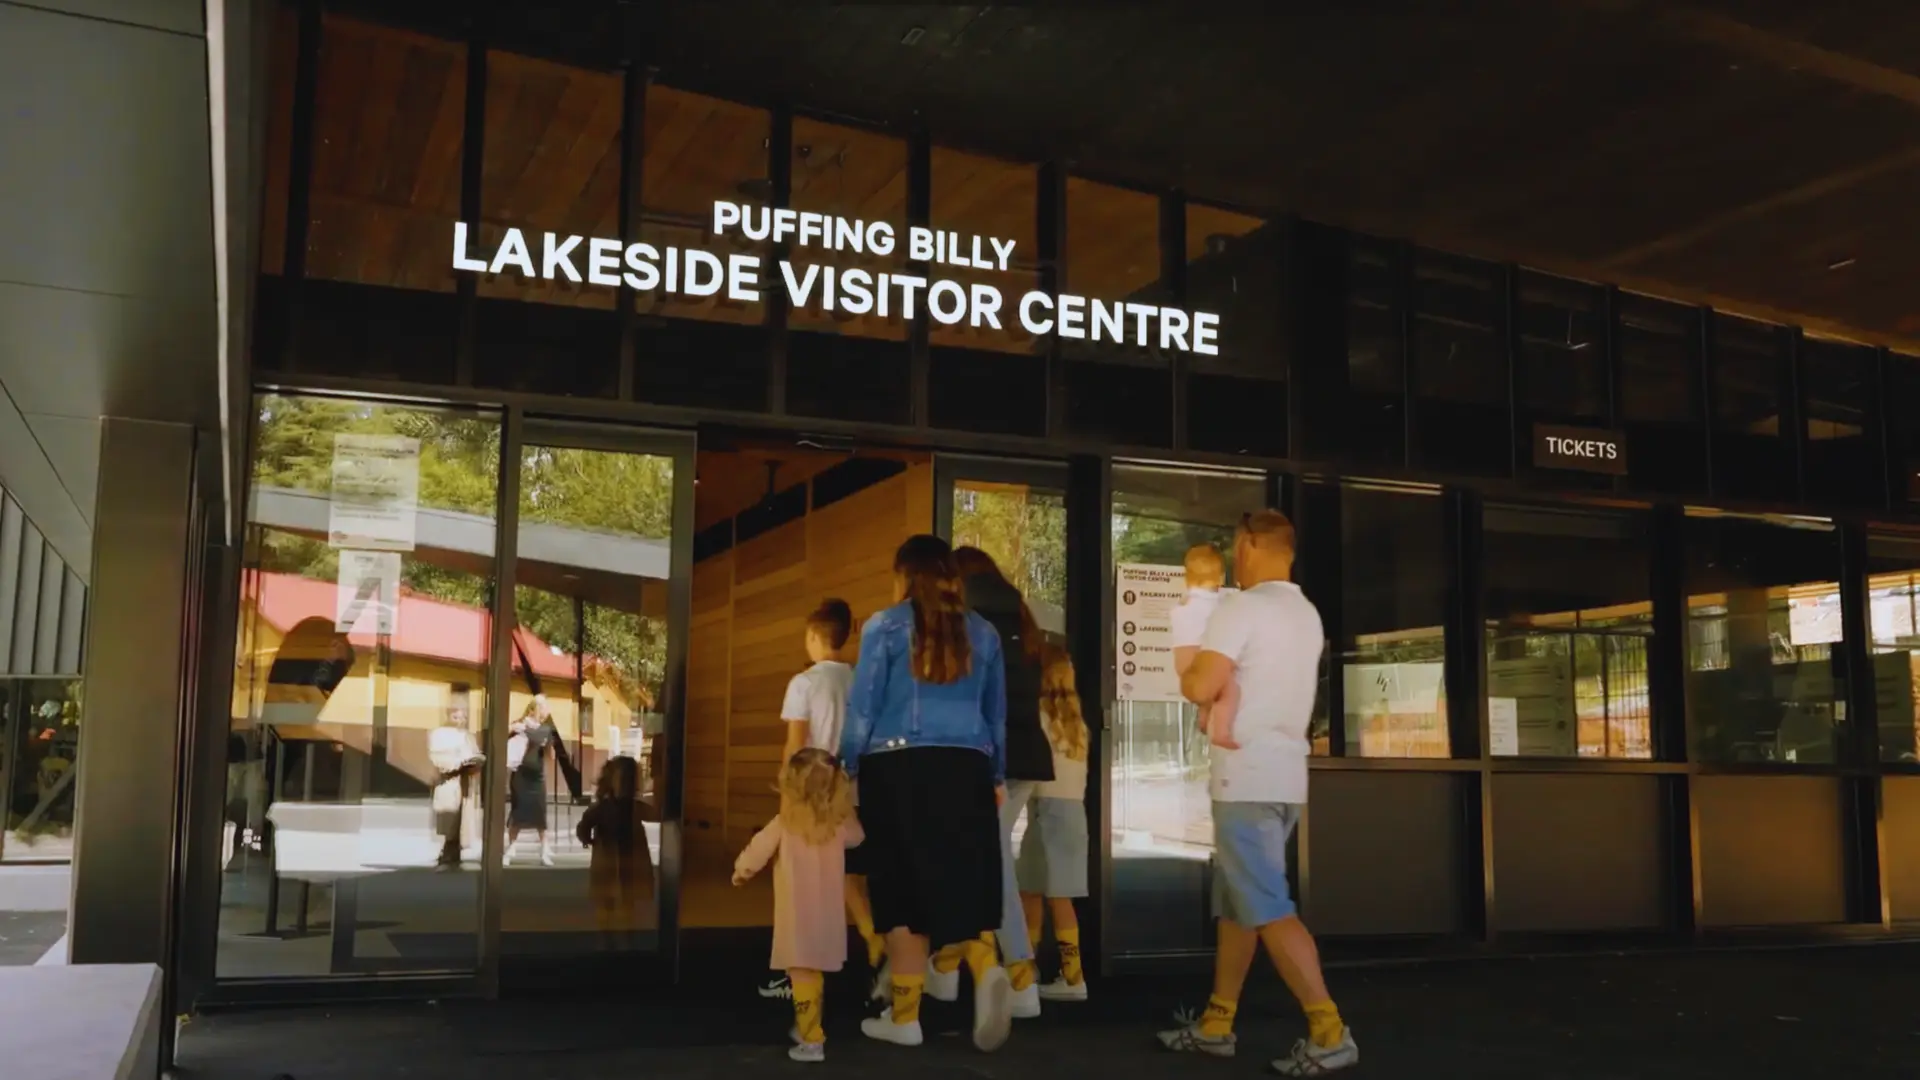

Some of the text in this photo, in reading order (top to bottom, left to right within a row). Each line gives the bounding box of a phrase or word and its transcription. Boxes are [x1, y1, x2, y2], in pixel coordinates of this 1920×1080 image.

[713, 200, 1017, 272] PUFFING BILLY
[452, 221, 1220, 356] LAKESIDE VISITOR CENTRE
[1545, 436, 1617, 459] TICKETS
